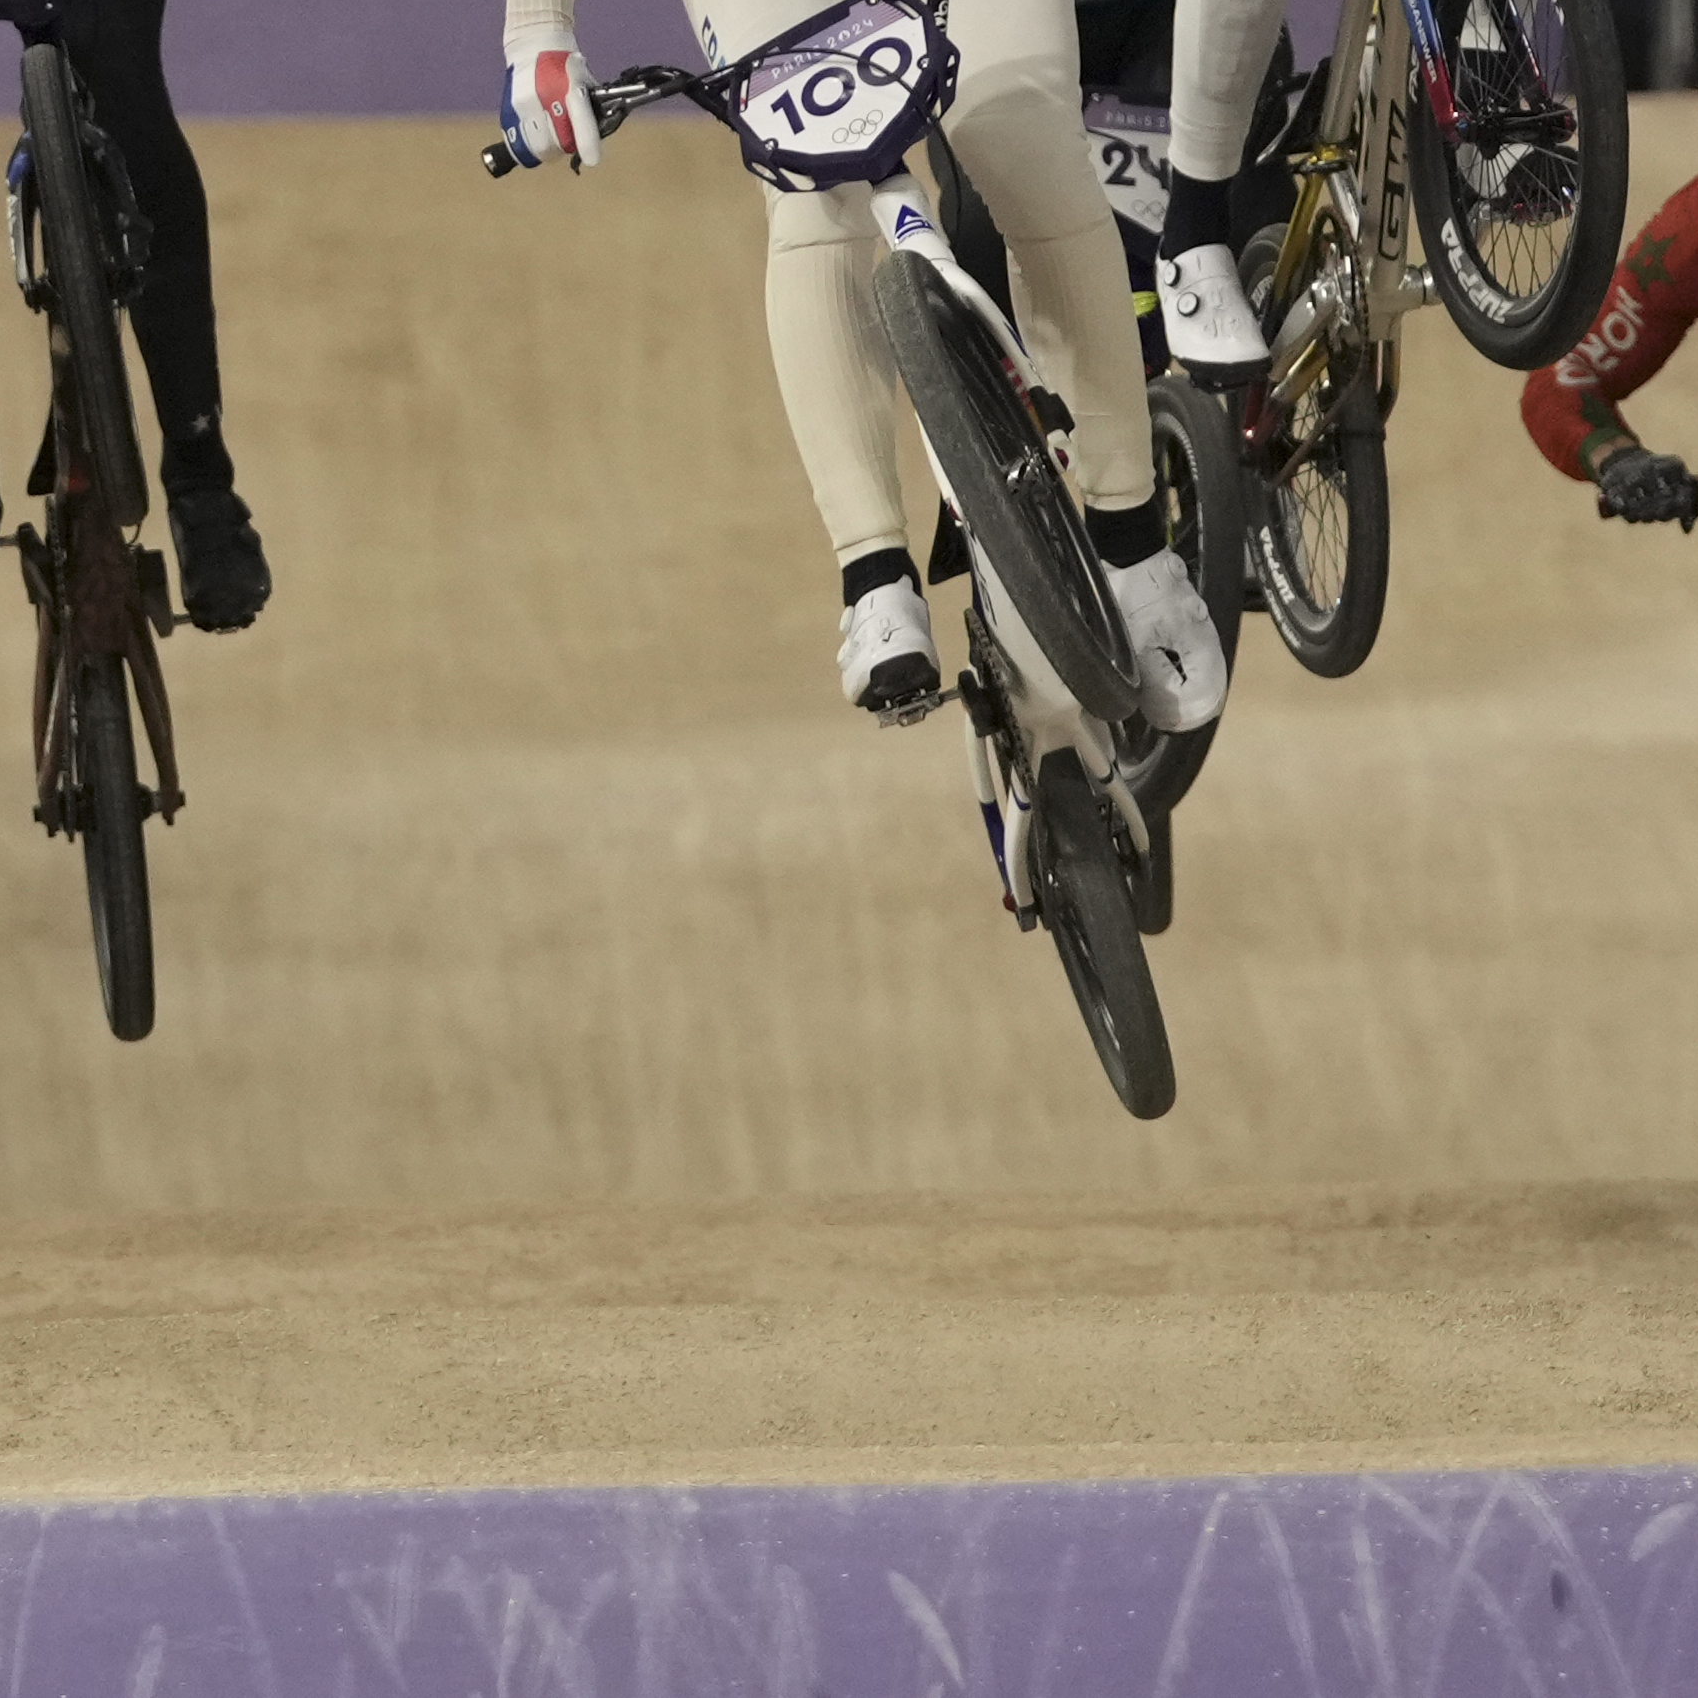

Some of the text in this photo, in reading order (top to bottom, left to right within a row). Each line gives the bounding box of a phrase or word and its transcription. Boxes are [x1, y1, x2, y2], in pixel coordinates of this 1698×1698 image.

[770, 17, 875, 81] PARIS 2024
[1412, 13, 1439, 85] ANSWER
[769, 36, 912, 136] 100
